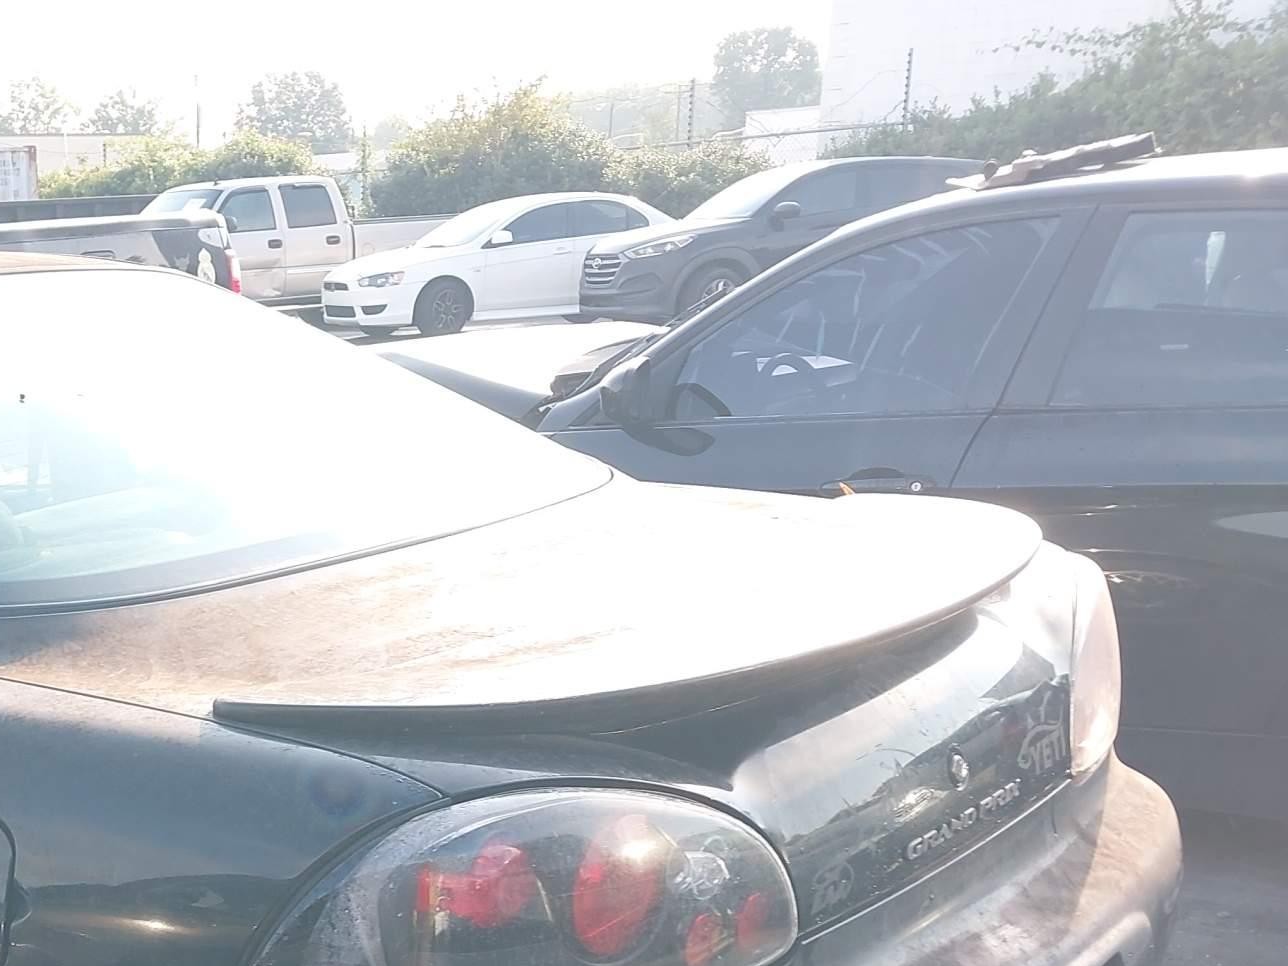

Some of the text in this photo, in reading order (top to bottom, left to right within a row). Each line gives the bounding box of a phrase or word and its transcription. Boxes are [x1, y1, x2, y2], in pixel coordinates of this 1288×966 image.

[1029, 726, 1067, 775] YETI
[906, 779, 1022, 860] GRAND PRIX
